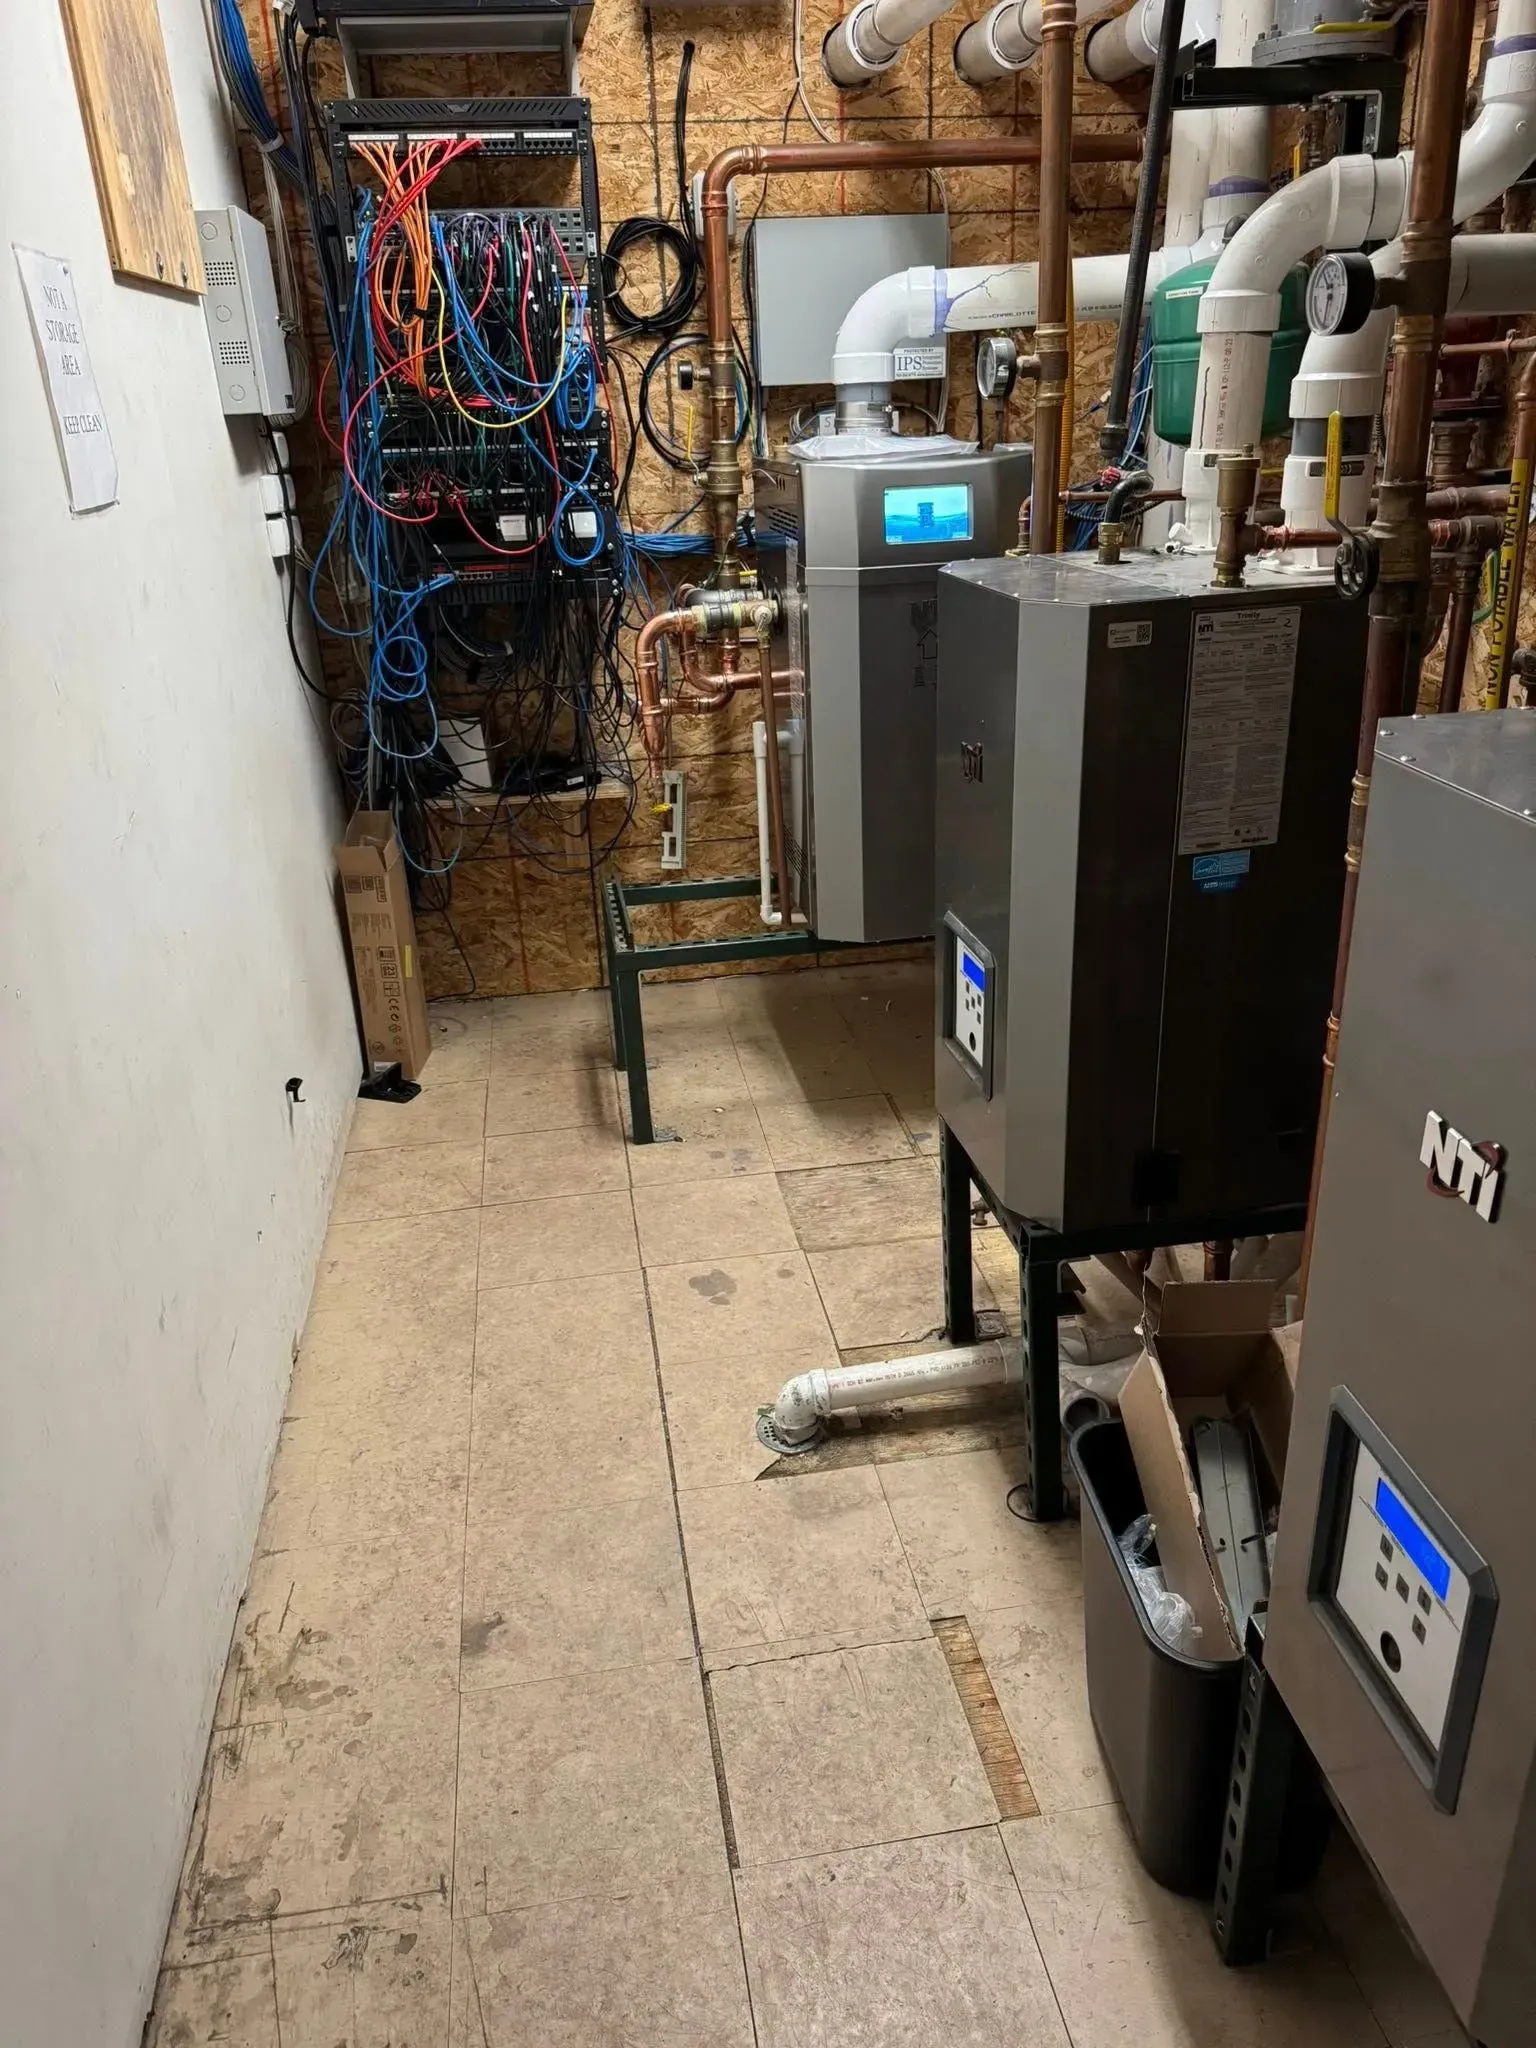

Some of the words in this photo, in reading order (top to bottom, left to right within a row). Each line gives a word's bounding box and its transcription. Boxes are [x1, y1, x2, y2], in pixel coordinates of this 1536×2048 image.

[43, 284, 58, 309] NOT
[59, 292, 68, 311] A
[45, 319, 80, 344] STORAGE
[61, 354, 82, 376] AREA
[896, 355, 922, 371] IPS
[63, 415, 80, 435] KEEP
[80, 414, 103, 433] CLEAN
[1283, 618, 1292, 628] 2
